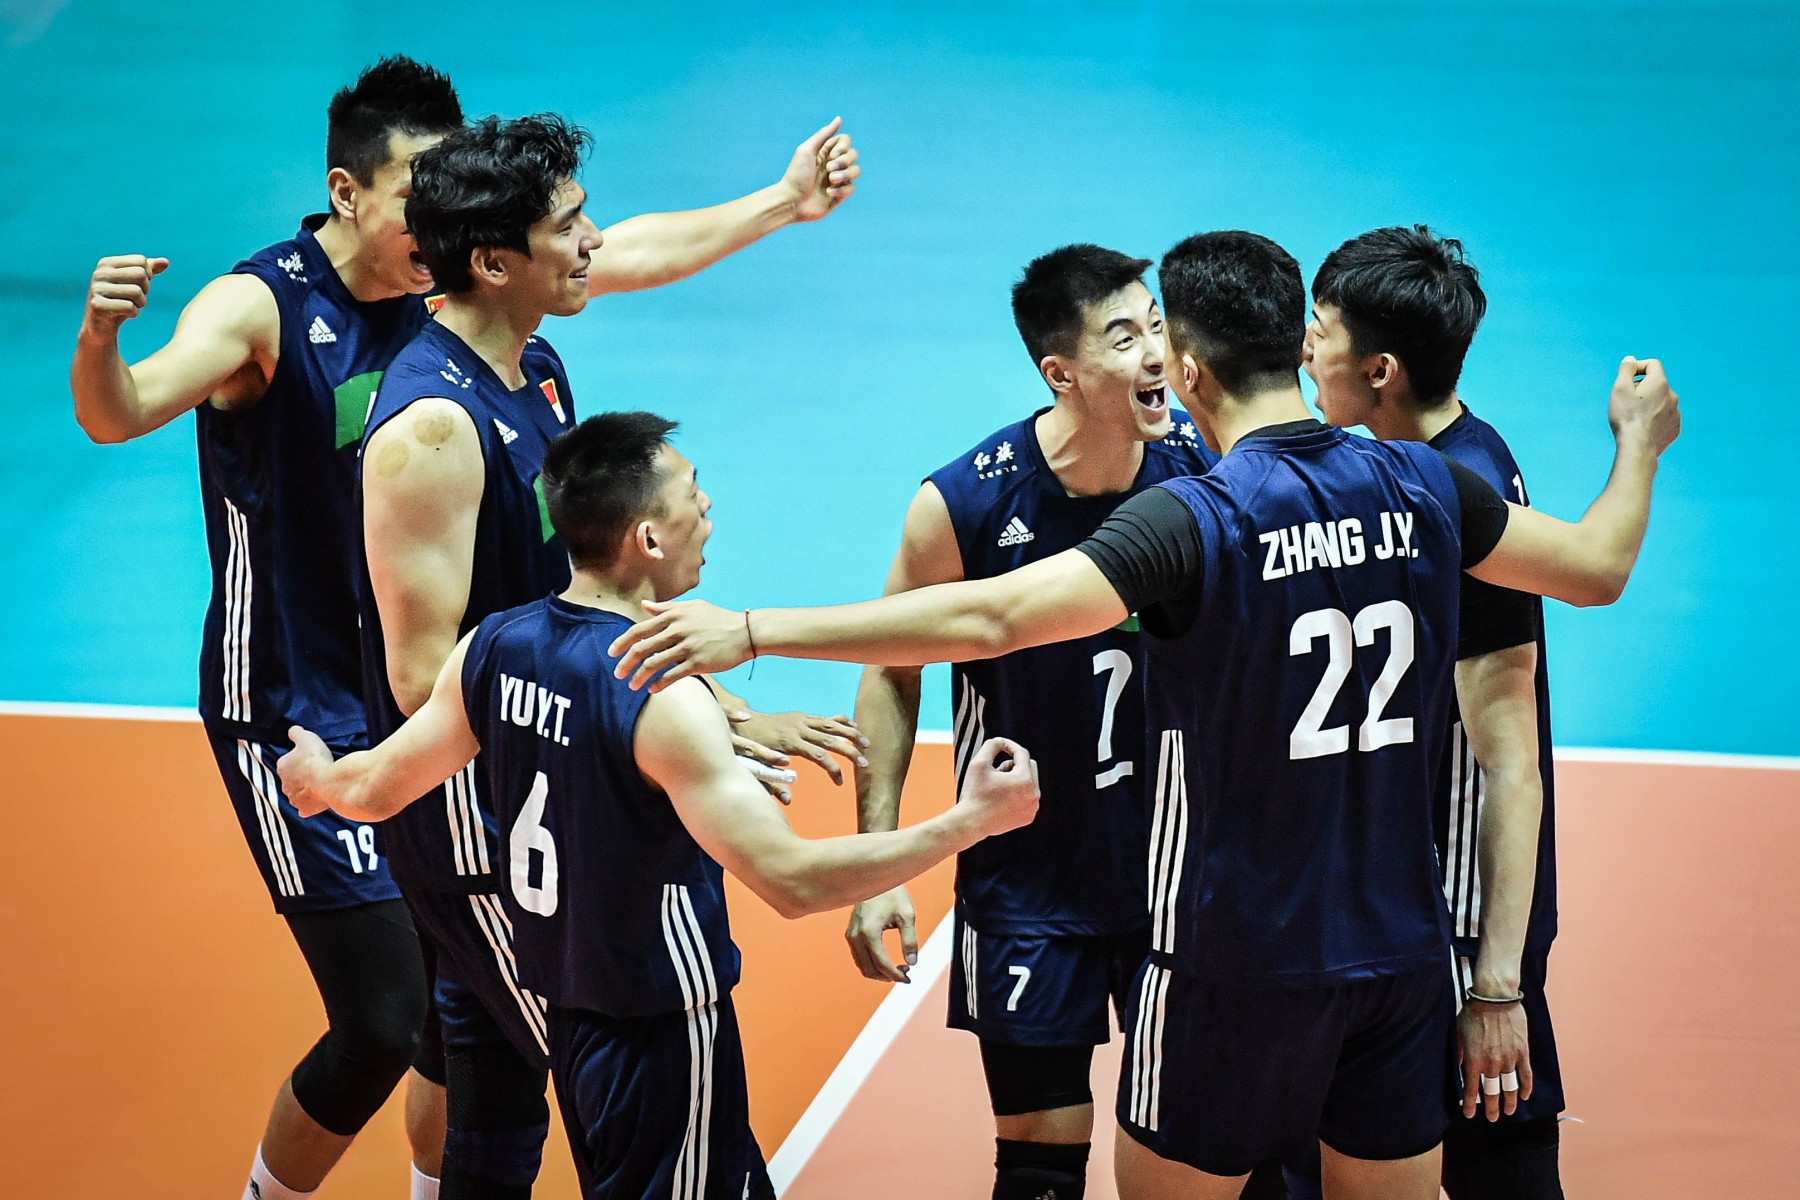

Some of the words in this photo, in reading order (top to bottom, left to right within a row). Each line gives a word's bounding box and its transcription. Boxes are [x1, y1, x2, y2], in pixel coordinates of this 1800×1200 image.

[997, 532, 1035, 548] adidas
[1258, 517, 1366, 581] ZHANG
[1093, 649, 1133, 763] 7
[1289, 600, 1414, 760] 22
[336, 825, 379, 874] 19
[510, 770, 559, 918] 6
[1007, 966, 1031, 1011] 7
